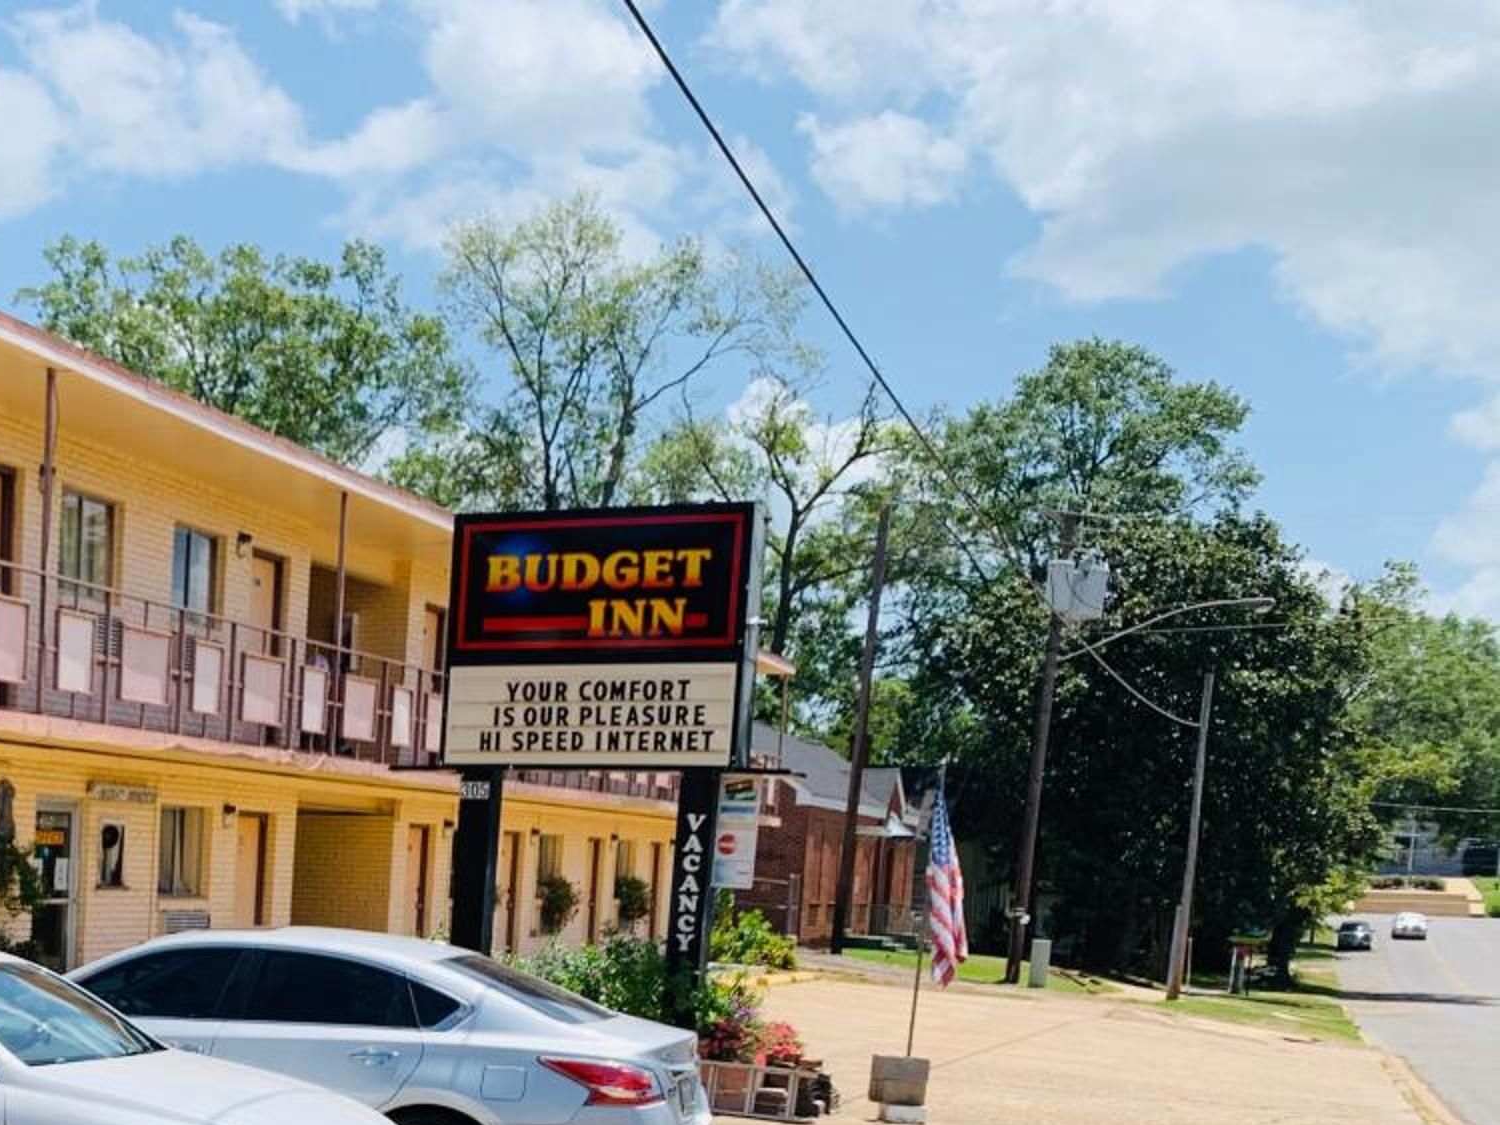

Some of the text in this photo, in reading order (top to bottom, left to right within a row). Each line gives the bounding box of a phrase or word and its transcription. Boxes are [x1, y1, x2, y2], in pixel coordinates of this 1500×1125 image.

[485, 548, 712, 592] BUDGET
[587, 598, 687, 637] INN
[506, 679, 691, 702] YOUR COMFORT
[493, 704, 707, 728] IS OUR PLEASURE
[479, 730, 716, 752] HI SPEED INTERNET
[676, 813, 707, 952] VACANCY
